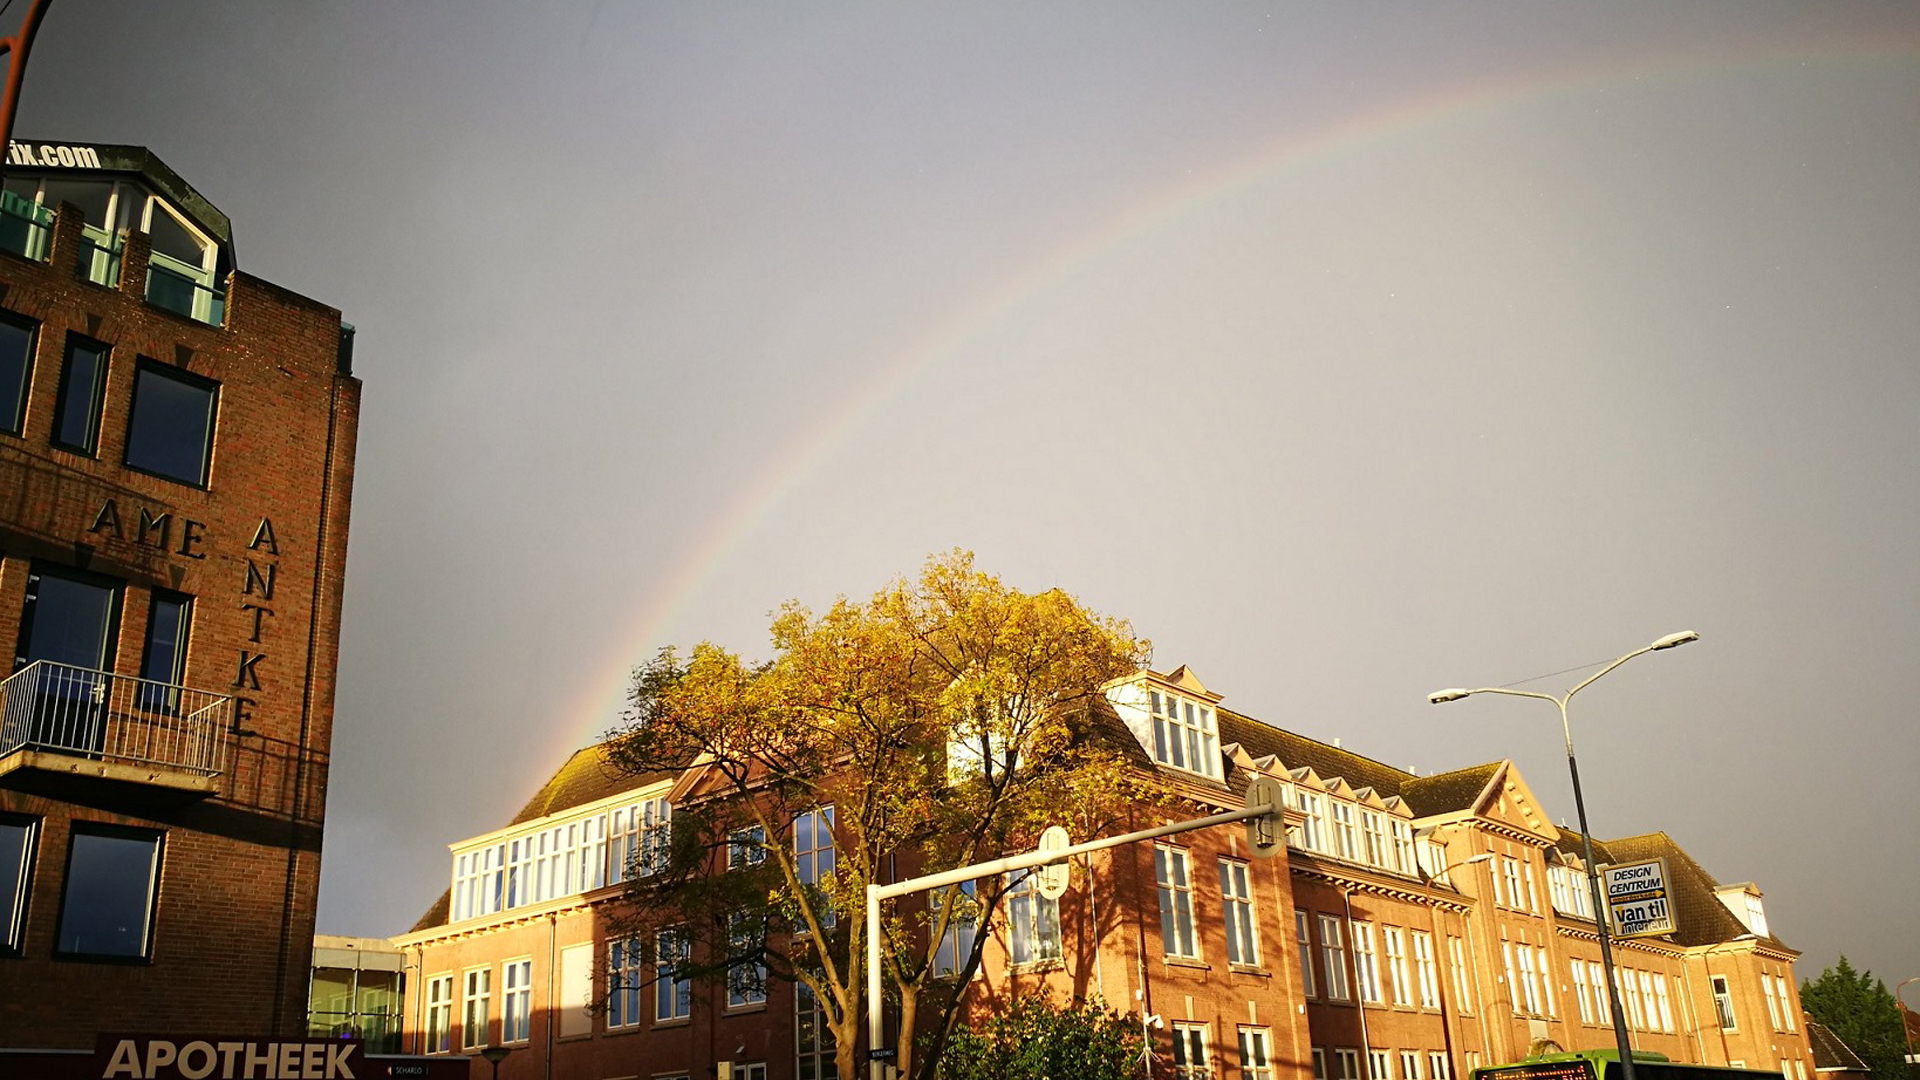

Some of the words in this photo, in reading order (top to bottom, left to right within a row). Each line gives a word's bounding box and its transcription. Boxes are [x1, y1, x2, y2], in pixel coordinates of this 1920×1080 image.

[6, 139, 101, 168] ix.com
[88, 498, 206, 560] AME
[1609, 878, 1661, 894] CENTRUM
[1613, 866, 1652, 881] DESIGN
[1614, 906, 1646, 923] van
[1648, 899, 1666, 918] til
[102, 1039, 357, 1079] APOTHEEK
